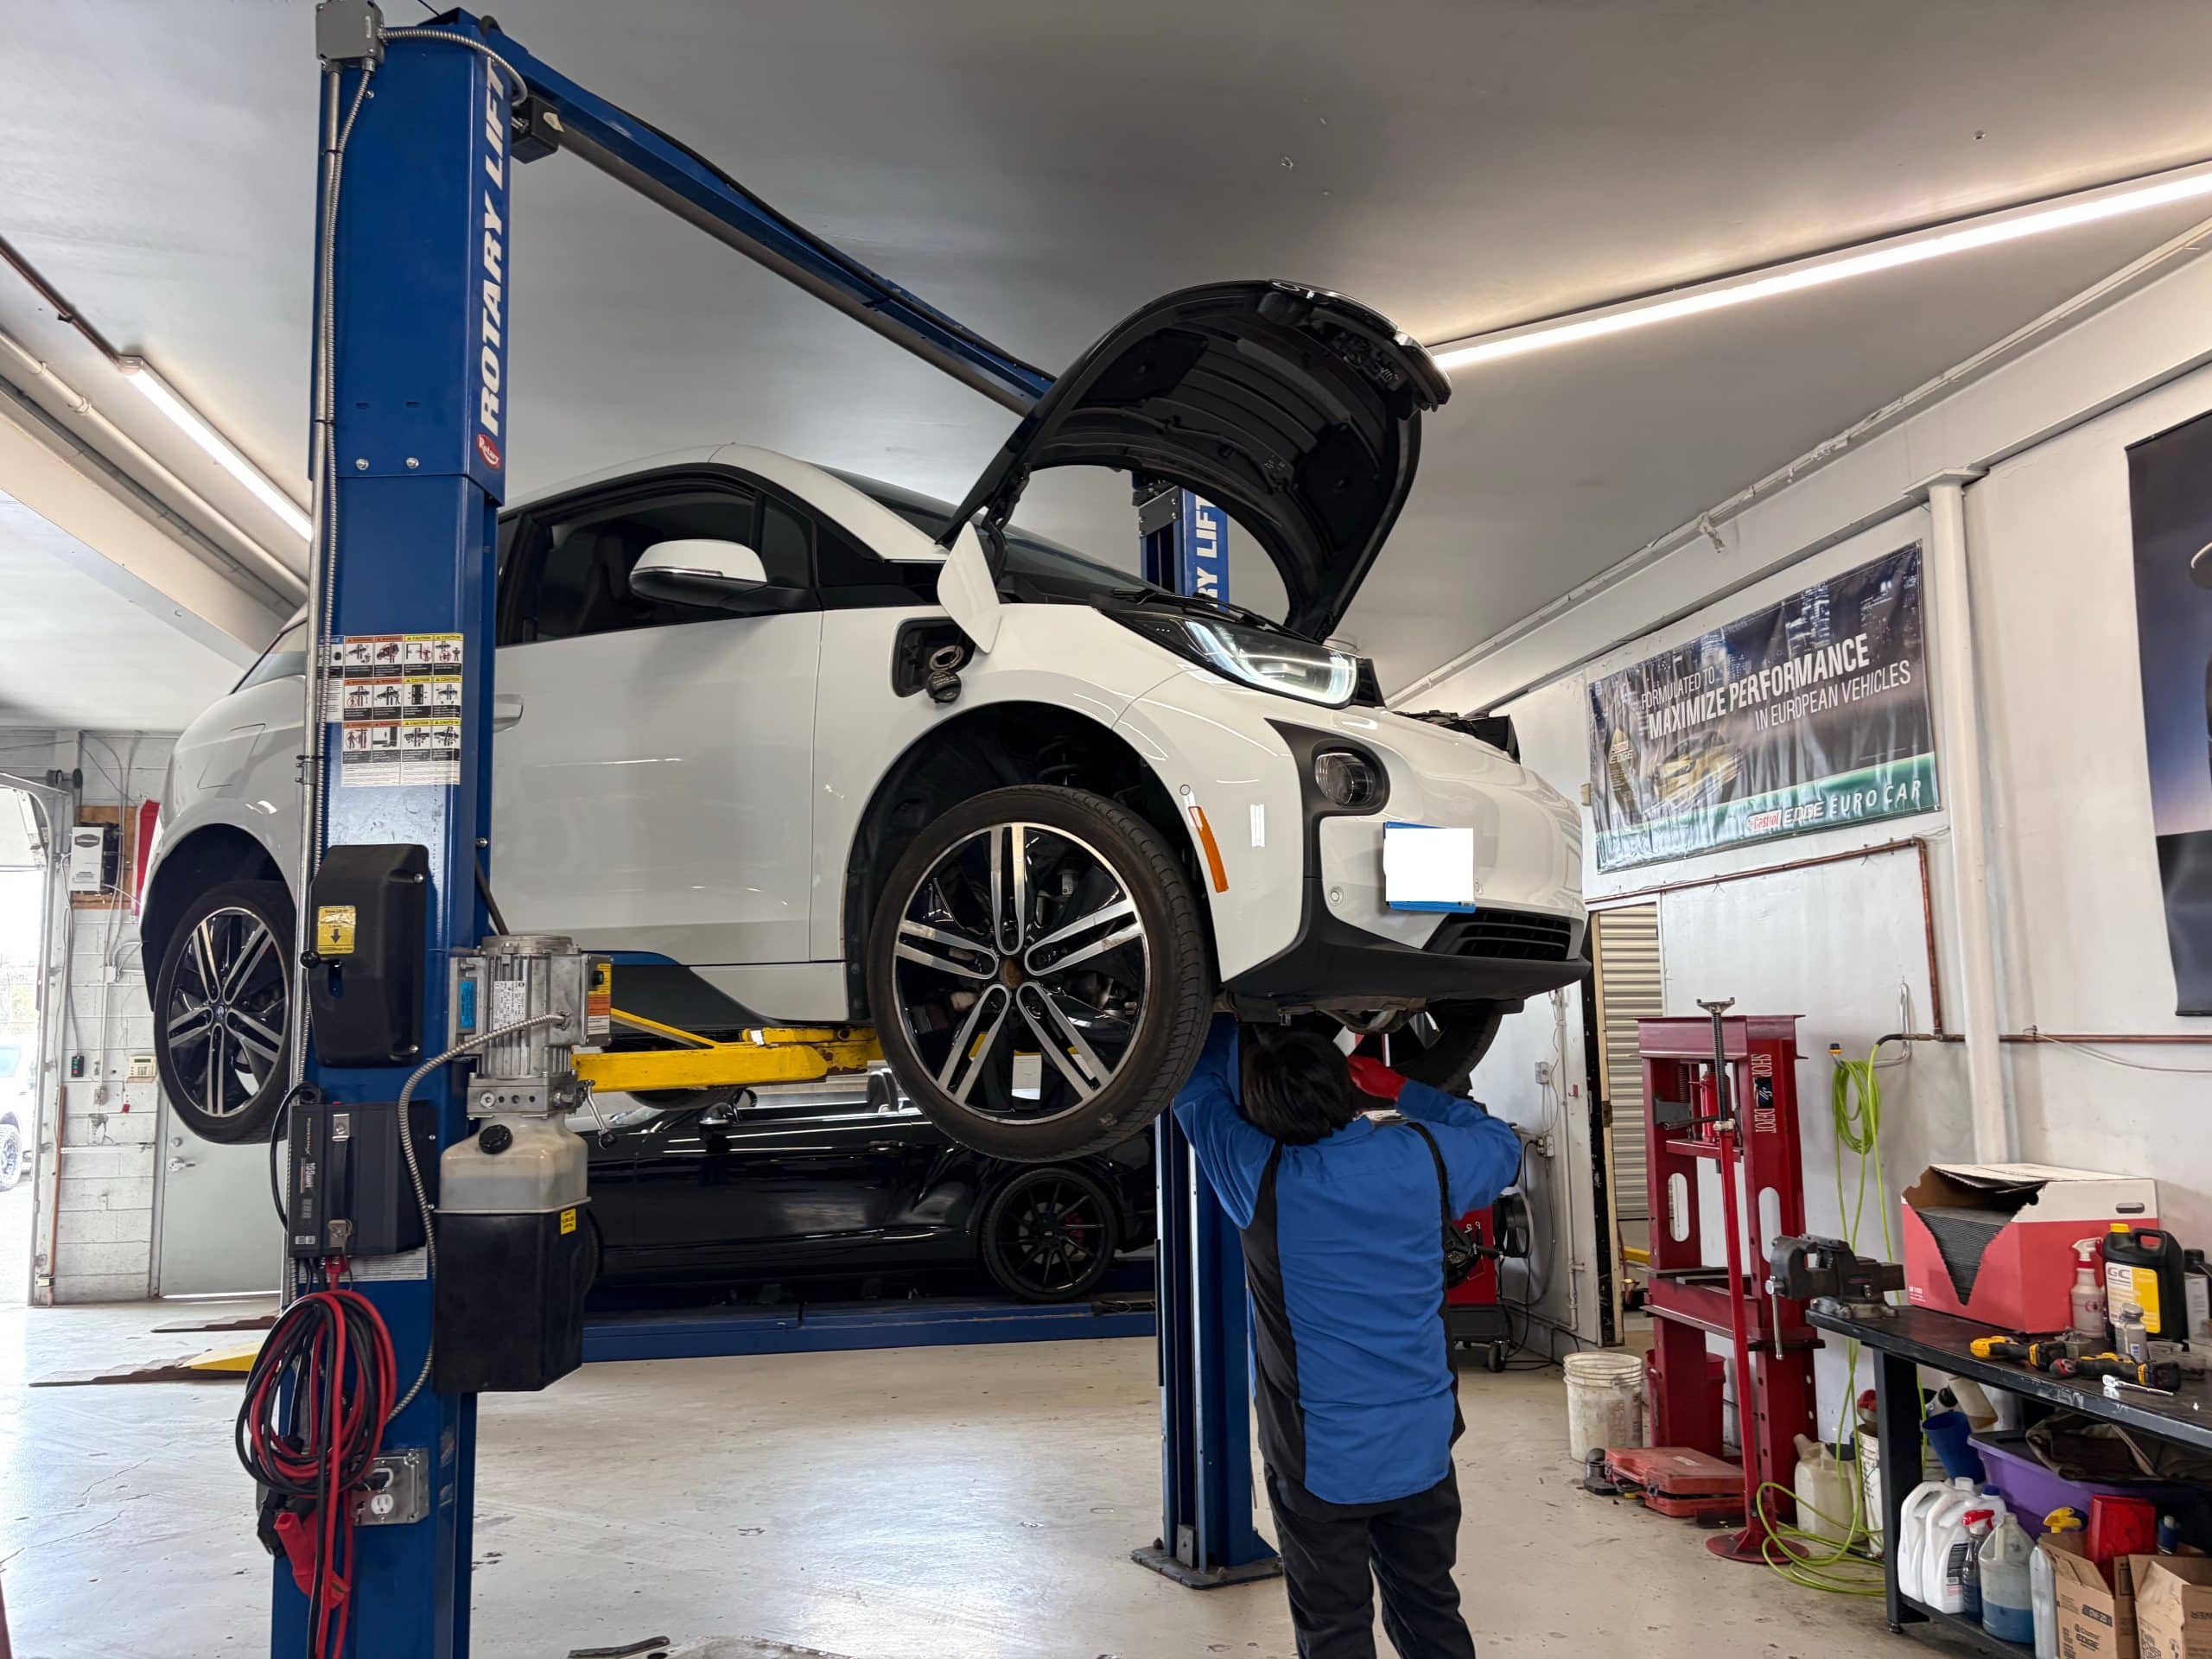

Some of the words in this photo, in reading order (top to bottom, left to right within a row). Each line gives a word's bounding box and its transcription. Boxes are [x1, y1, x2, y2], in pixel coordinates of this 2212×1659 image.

[485, 56, 505, 191] LIFT
[480, 189, 503, 437] ROTARY
[1195, 495, 1217, 558] LIFT
[1197, 566, 1218, 608] RY
[1642, 672, 1701, 711] FORMULATED
[1703, 665, 1715, 685] TO
[1648, 687, 1727, 741] MAXIMIZE
[1729, 632, 1870, 713] PERFORMANCE
[1755, 709, 1769, 732] IN
[1770, 683, 1839, 727] EUROPEAN
[1841, 659, 1911, 704] VEHICLES
[1753, 813, 1779, 830] Castrol
[1783, 800, 1825, 825] EDGE
[1831, 789, 1878, 817] EURO
[1884, 779, 1922, 805] CAR
[1751, 1053, 1773, 1077] SHOP
[1754, 1108, 1777, 1134] DEPOT
[2107, 1266, 2131, 1280] GC
